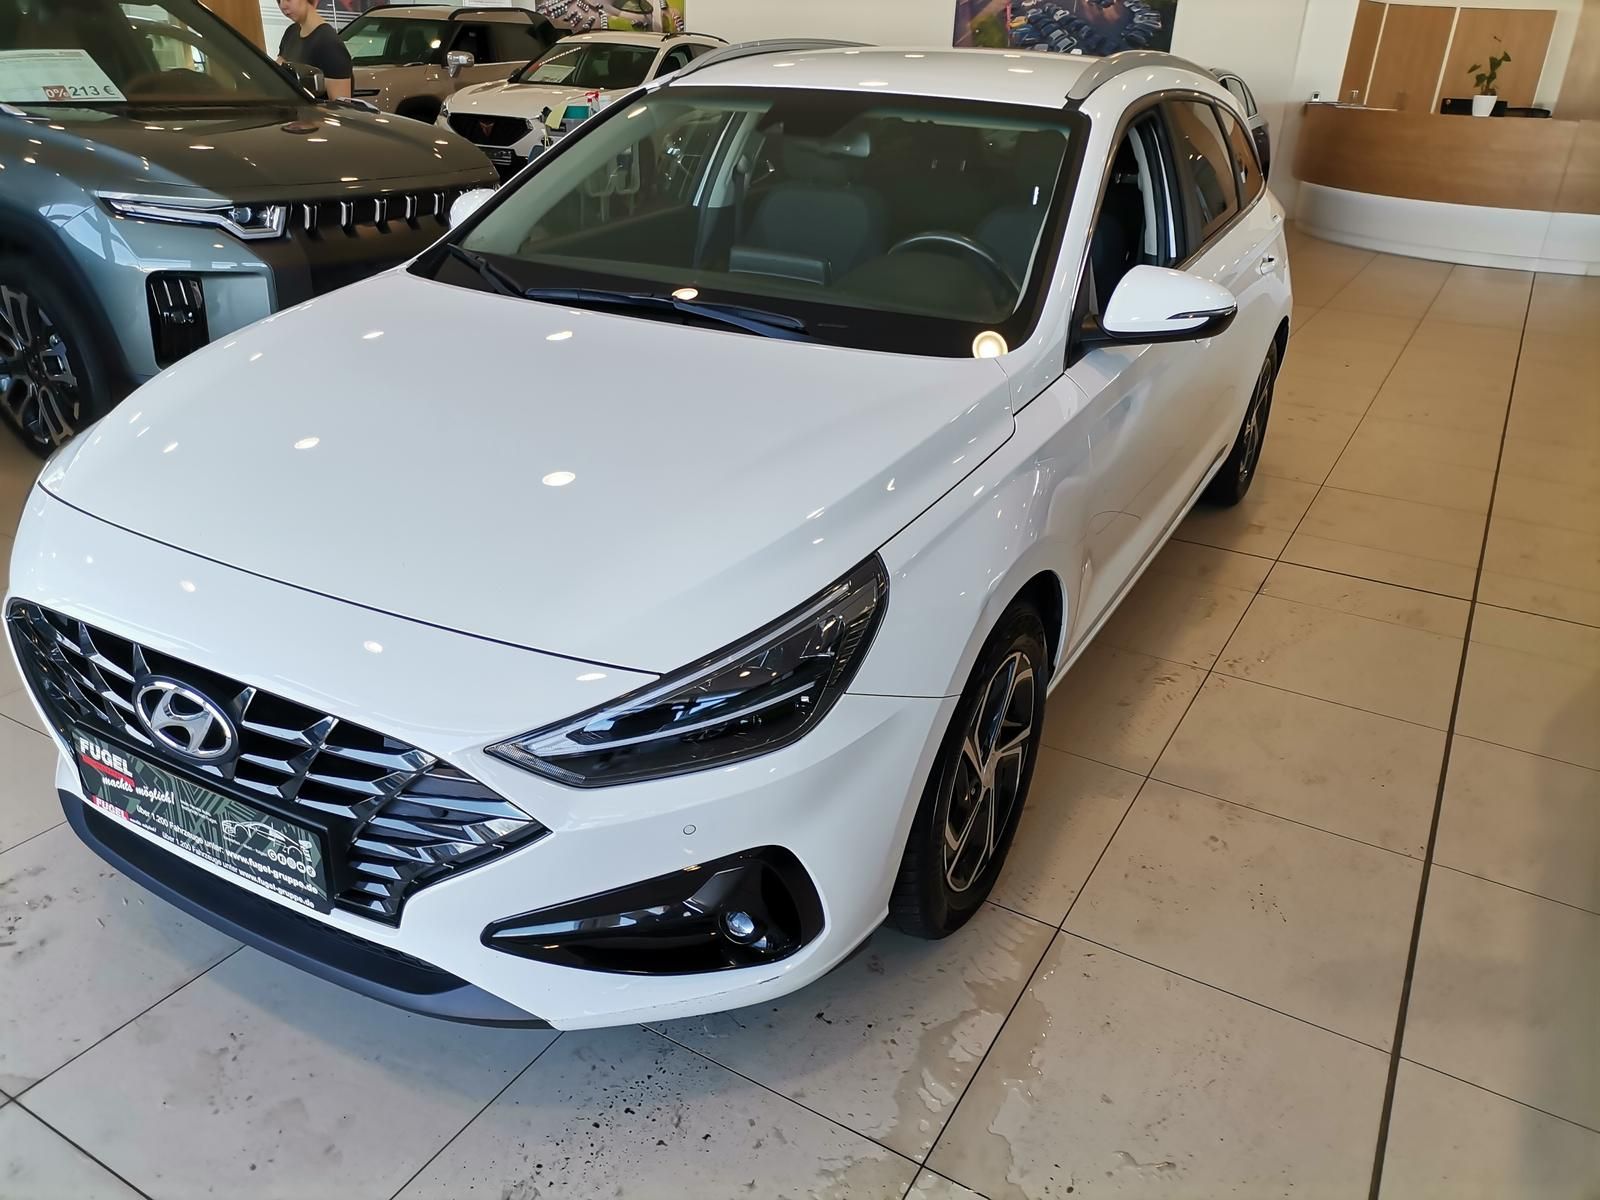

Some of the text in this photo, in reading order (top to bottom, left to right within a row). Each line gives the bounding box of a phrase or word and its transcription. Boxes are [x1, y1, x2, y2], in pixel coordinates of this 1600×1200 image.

[68, 86, 100, 96] 213
[104, 86, 115, 95] €
[80, 737, 133, 778] FUGEL
[102, 776, 134, 793] machts
[95, 797, 129, 821] FUGEL
